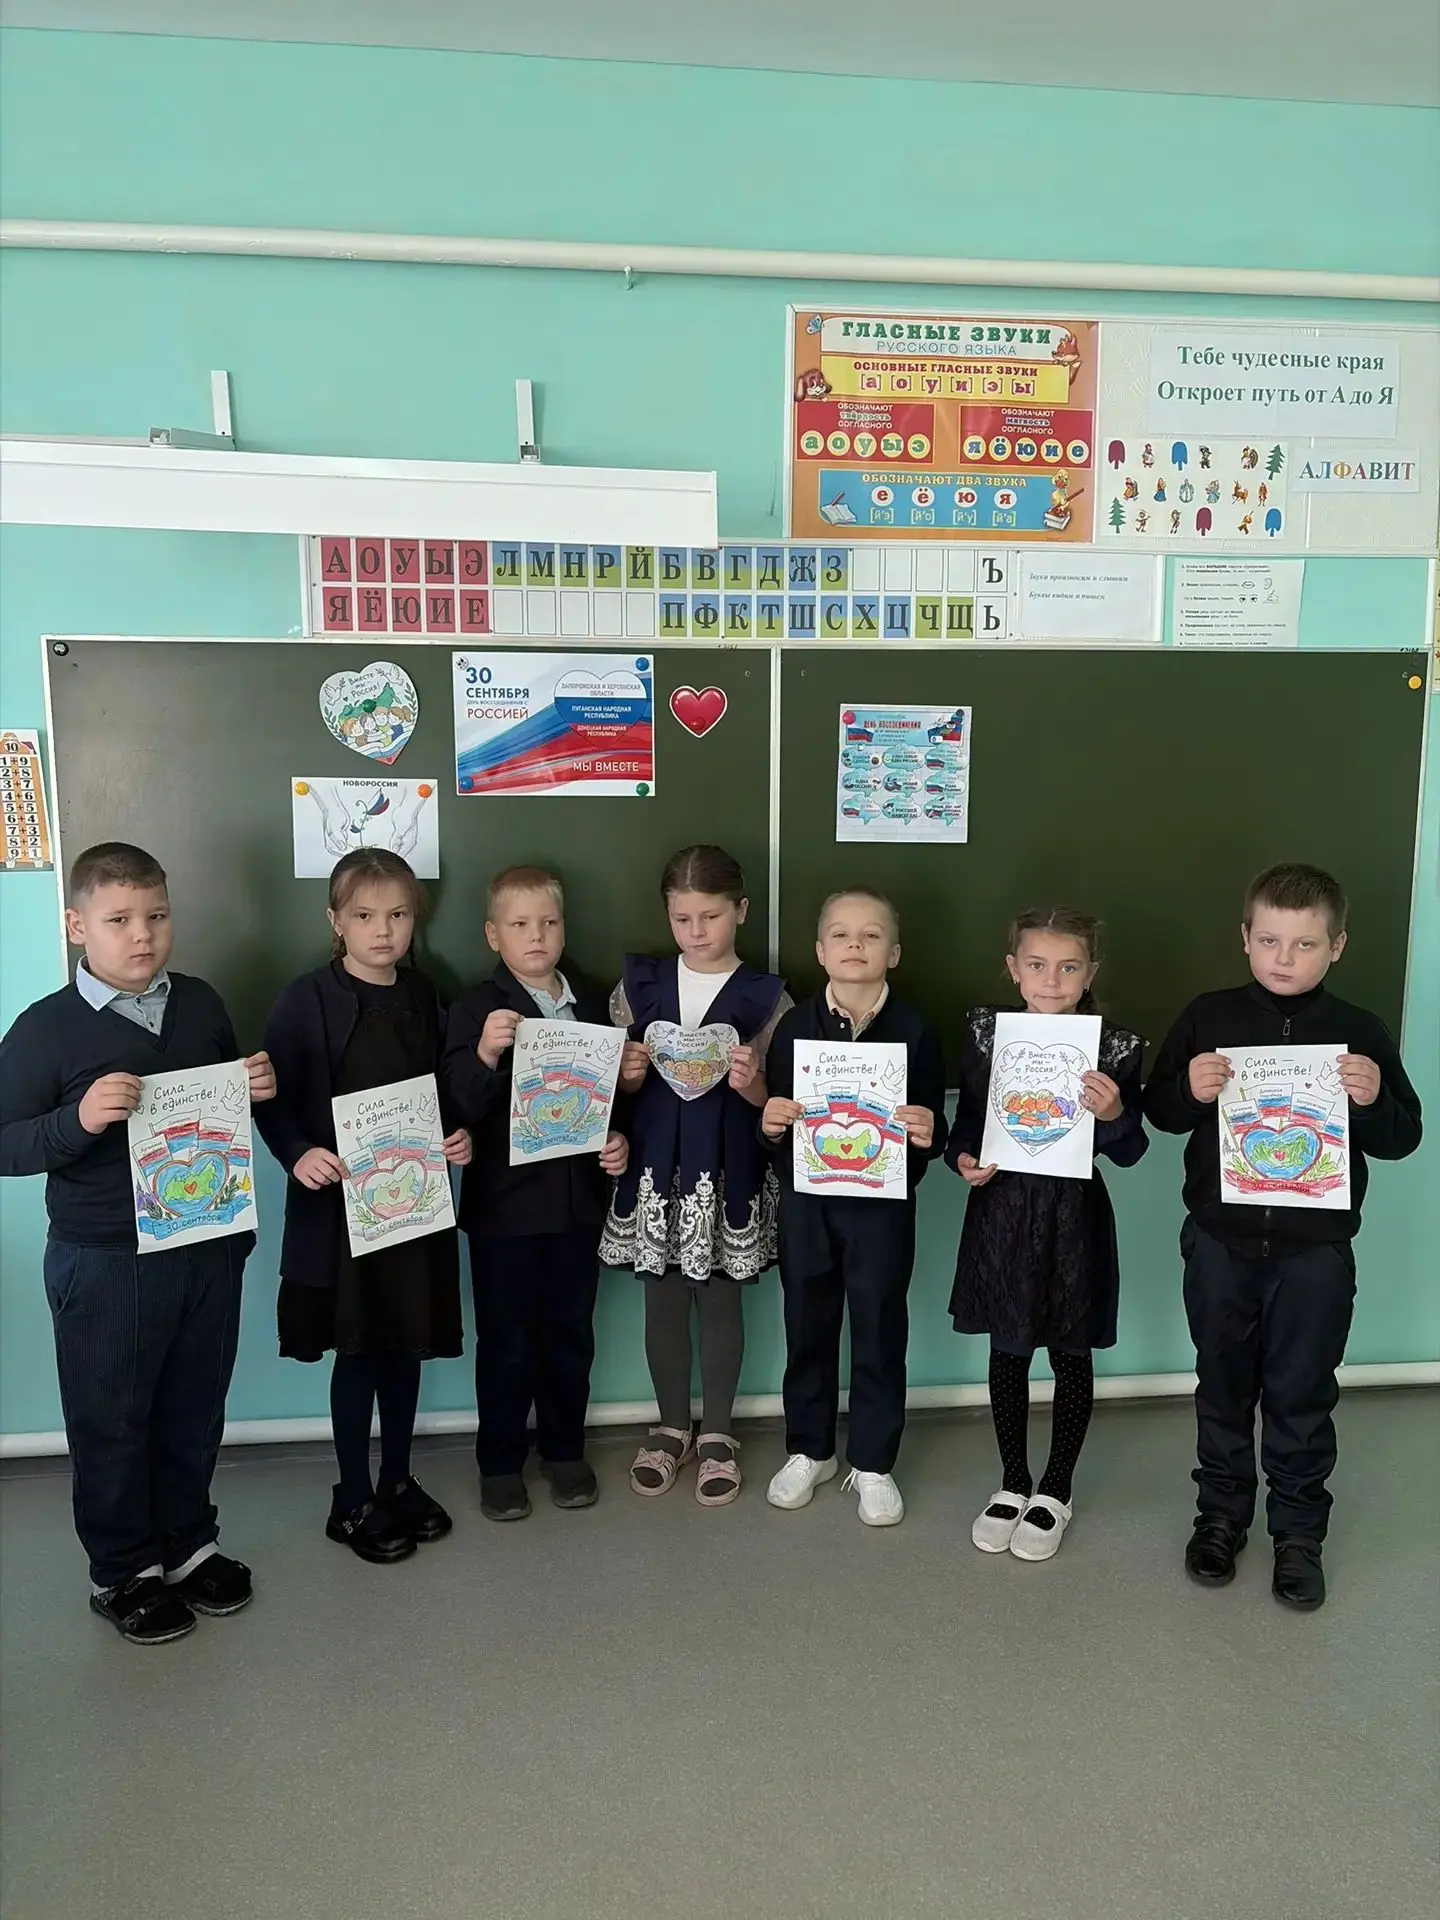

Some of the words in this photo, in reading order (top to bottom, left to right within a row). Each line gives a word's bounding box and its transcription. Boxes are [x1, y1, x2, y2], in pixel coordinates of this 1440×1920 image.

[842, 321, 960, 341] ГЛАСНЫЕ
[970, 327, 1051, 344] ЗВУКИ
[877, 341, 959, 354] РУССКОГО
[964, 344, 1017, 356] ЯЗЫКА
[1177, 346, 1225, 365] Тебе
[1232, 352, 1330, 371] чудесные
[1337, 355, 1384, 374] края
[854, 361, 928, 372] ОСНОВНЫЕ
[931, 364, 993, 374] ГЛАСНЫЕ
[997, 366, 1038, 377] ЗВУКИ
[1157, 381, 1246, 405] Откроет
[1251, 388, 1300, 406] путь
[1304, 389, 1327, 403] от
[1330, 385, 1346, 404] А
[1350, 392, 1373, 405] до
[1378, 387, 1395, 404] Я
[838, 403, 893, 411] ОБОЗНАЧАЮТ
[1001, 408, 1055, 417] ОБОЗНАЧАЮТ
[838, 421, 893, 429] СОГЛАСНОГО
[1006, 417, 1050, 426] мягкость
[1001, 426, 1054, 435] СОГЛАСНОГО
[1299, 461, 1416, 481] АЛФАВИТ
[862, 474, 953, 484] ОБОЗНАЧАЮТ
[956, 476, 982, 485] ДВА
[985, 477, 1027, 487] ЗВУКА
[326, 546, 348, 573] А
[360, 547, 380, 574] О
[396, 548, 416, 574] У
[425, 549, 453, 575] Ы
[465, 548, 483, 576] Э
[497, 550, 519, 577] Л
[530, 551, 555, 577] М
[563, 551, 586, 578] Н
[596, 552, 615, 578] Р
[630, 546, 652, 579] Й
[663, 554, 681, 580] Б
[696, 555, 715, 580] В
[731, 555, 747, 580] Г
[760, 556, 780, 588] Д
[789, 556, 816, 582] Ж
[826, 556, 842, 582] З
[983, 558, 1003, 583] Ъ
[329, 596, 349, 622] Я
[364, 591, 383, 623] Ё
[393, 597, 421, 624] Ю
[430, 598, 453, 624] И
[467, 598, 485, 624] Е
[663, 603, 685, 629] П
[694, 603, 718, 629] Ф
[728, 604, 748, 629] К
[761, 604, 780, 630] Т
[789, 604, 816, 629] Ш
[826, 604, 843, 630] С
[856, 604, 877, 630] Х
[887, 605, 909, 636] Ц
[920, 605, 939, 630] Ч
[947, 605, 973, 636] Щ
[983, 605, 1001, 630] Ь
[348, 673, 374, 685] Вместе
[466, 667, 492, 684] 30
[351, 682, 380, 698] Россия!
[466, 688, 529, 698] СЕНТЯБРЯ
[468, 707, 528, 719] РОССИЕЙ
[5, 743, 19, 752] 10
[573, 762, 592, 771] МЫ
[595, 762, 639, 771] ВМЕСТЕ
[343, 780, 398, 788] НОВОРОССИЯ
[537, 1029, 564, 1039] Сила
[533, 1042, 538, 1051] в
[543, 1039, 594, 1051] единстве!
[819, 1052, 847, 1063] Сила
[1028, 1051, 1056, 1059] Вместе
[1245, 1057, 1276, 1068] Сила
[815, 1066, 822, 1076] в
[825, 1064, 877, 1077] единстве!
[1025, 1065, 1057, 1073] Россия!
[1241, 1071, 1248, 1081] в
[1254, 1065, 1312, 1081] единстве!
[154, 1085, 185, 1100] Сила
[150, 1105, 158, 1115] в
[162, 1087, 217, 1112] единстве!
[357, 1098, 385, 1116] Сила
[356, 1119, 362, 1129] в
[367, 1099, 413, 1126] единстве!
